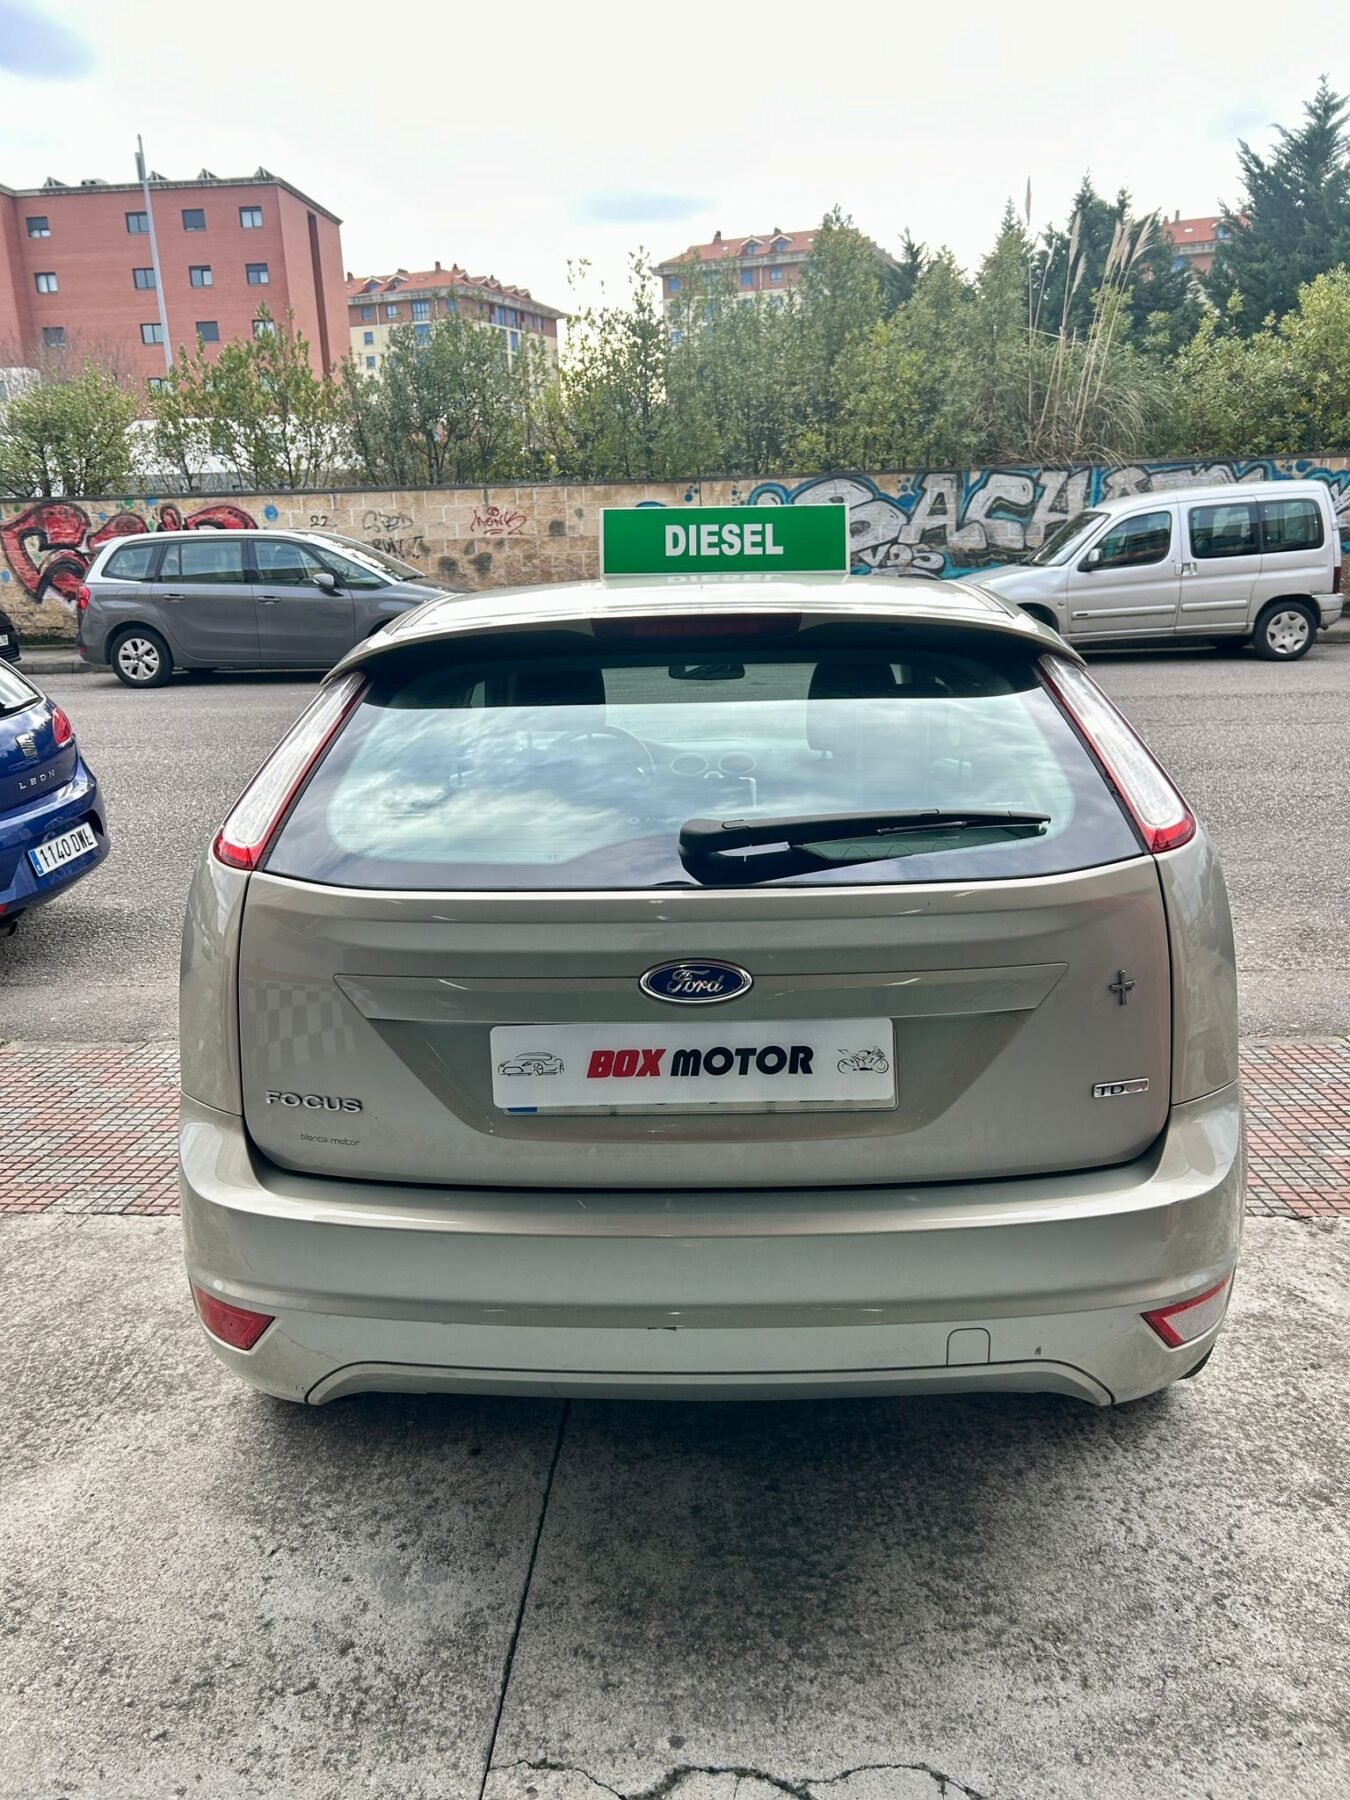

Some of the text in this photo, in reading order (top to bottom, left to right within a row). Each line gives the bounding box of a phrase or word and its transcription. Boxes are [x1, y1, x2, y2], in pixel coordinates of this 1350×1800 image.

[309, 515, 331, 528] 22
[664, 523, 784, 557] DIESEL
[18, 769, 55, 790] LEON
[40, 838, 71, 868] 1140
[666, 969, 725, 994] Ford
[586, 1045, 815, 1079] BOX MOTOR
[265, 1090, 363, 1113] FOCUS
[330, 1137, 360, 1146] motor
